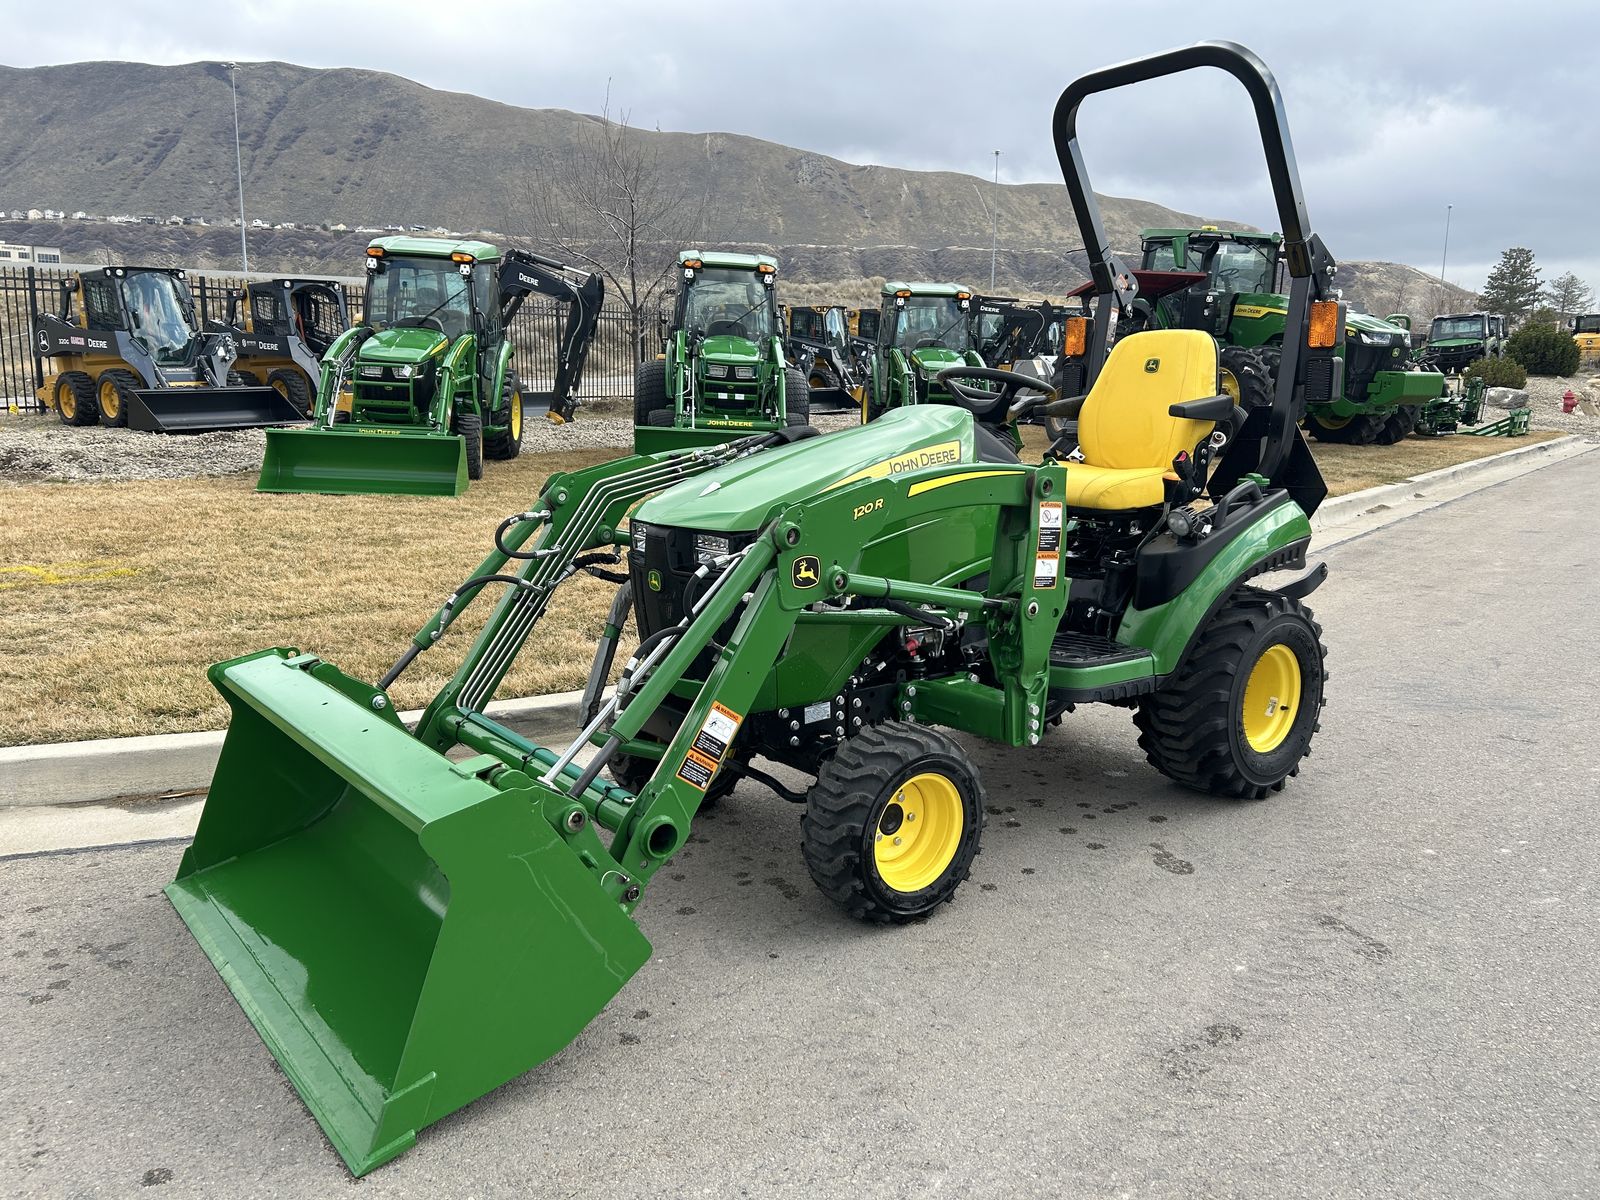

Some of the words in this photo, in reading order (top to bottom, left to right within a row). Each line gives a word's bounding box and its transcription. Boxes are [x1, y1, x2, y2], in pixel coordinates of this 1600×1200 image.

[518, 272, 539, 286] DEERE
[980, 305, 1000, 313] DEERE
[87, 338, 108, 349] DEERE
[258, 341, 279, 350] DEERE
[801, 343, 820, 354] DEERE
[887, 458, 919, 476] JOHN
[919, 449, 957, 468] DEERE
[852, 502, 874, 520] 120
[874, 498, 885, 511] R
[720, 707, 739, 721] WARNING
[695, 756, 714, 769] WARNING
